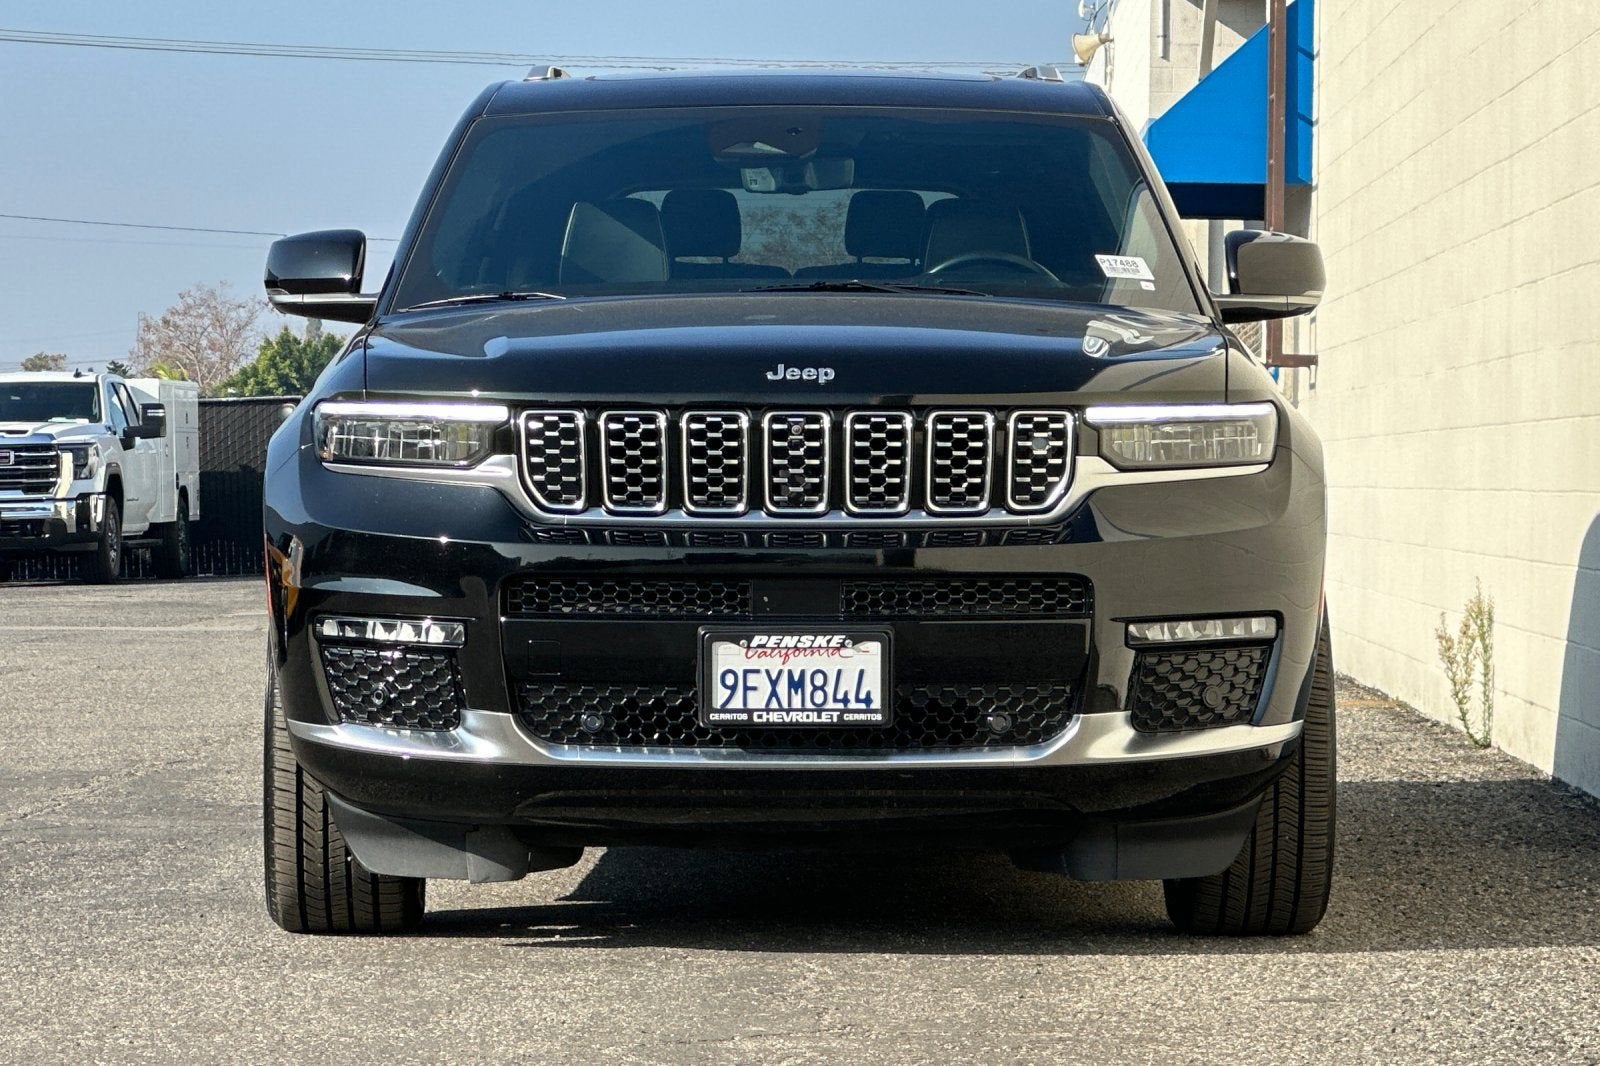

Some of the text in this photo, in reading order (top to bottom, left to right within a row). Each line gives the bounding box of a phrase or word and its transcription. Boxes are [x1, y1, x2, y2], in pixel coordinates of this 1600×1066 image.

[766, 363, 835, 384] Jeep
[750, 635, 846, 648] PENSKE
[719, 668, 873, 709] 9FXM844
[709, 711, 882, 722] CERRITOS CHEVROLET CERRITOS
